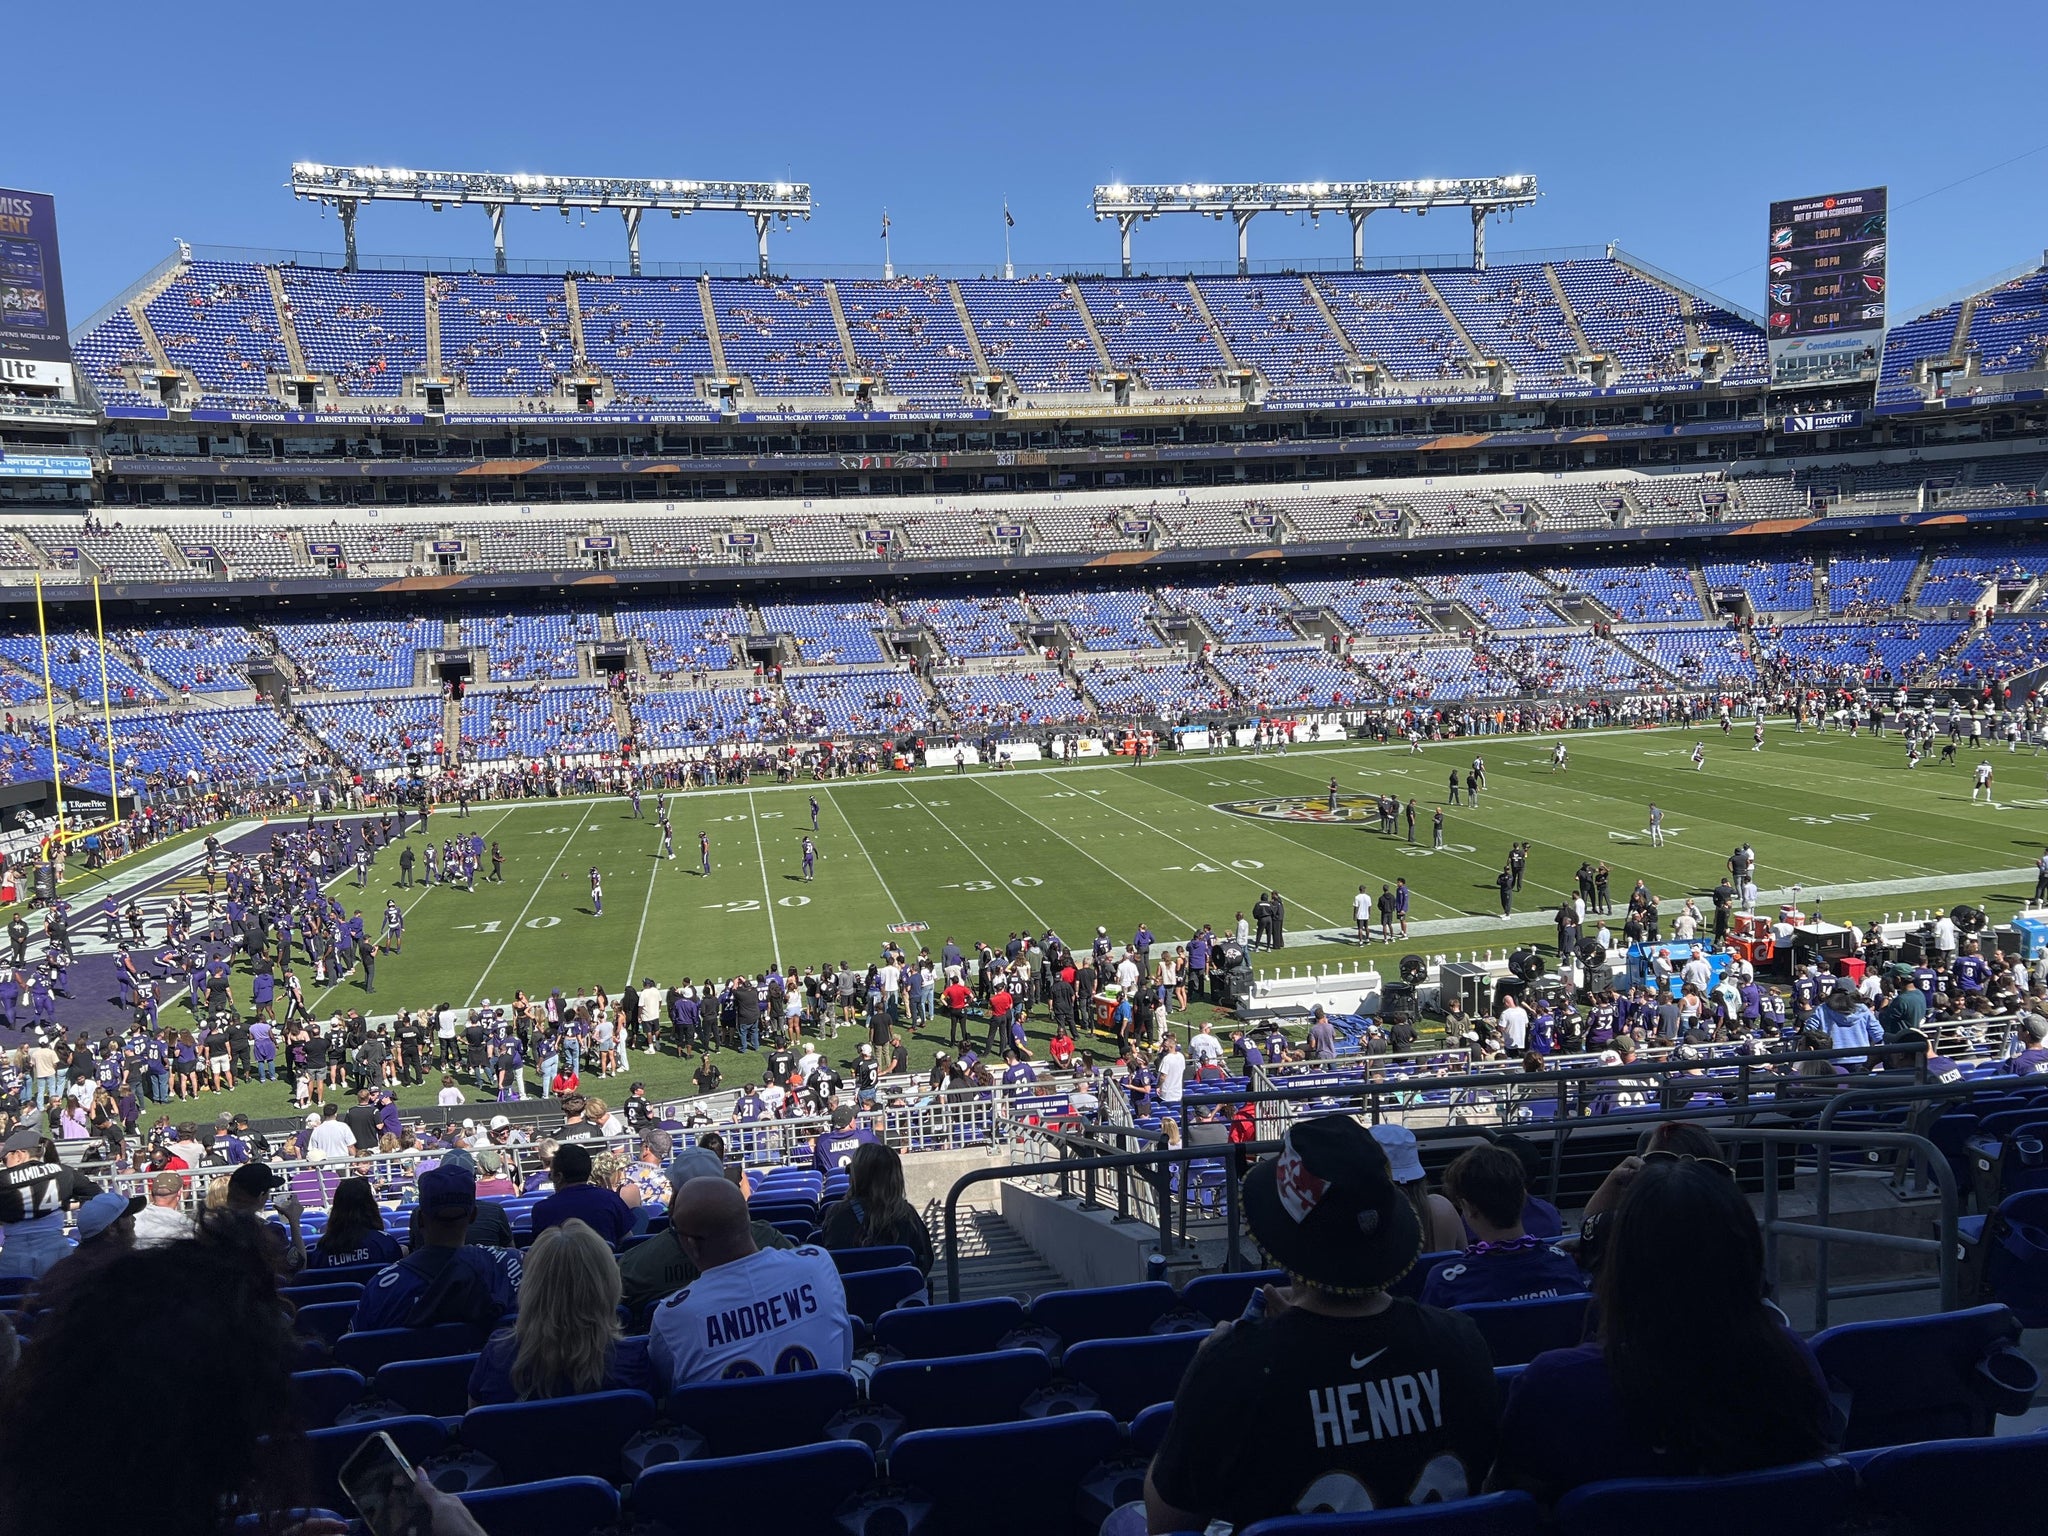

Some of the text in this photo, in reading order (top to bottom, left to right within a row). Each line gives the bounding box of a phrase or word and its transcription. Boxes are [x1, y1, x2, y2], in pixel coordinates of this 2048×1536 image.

[1793, 201, 1824, 212] MARYLAND
[1794, 205, 1863, 222] OUT OF TOWN SCOREBOARD
[1815, 227, 1841, 240] 1:00 PM
[1814, 256, 1840, 268] 1:00 PM
[1813, 283, 1840, 296] 4:05 PM
[1812, 312, 1840, 324] 4:05 PM
[20, 333, 45, 341] MOBILE
[1723, 378, 1769, 388] RING HONOR
[1520, 390, 1592, 401] BRIAN BILLICK 1999-2007
[1616, 384, 1694, 395] HALOTI NGATA 2006-2014
[1350, 401, 1368, 409] JAMAL
[1388, 398, 1417, 406] 2000-2006
[1430, 395, 1493, 405] TODD HEAP 2001-2010
[1127, 407, 1144, 415] LEWIS
[1267, 403, 1282, 411] MATT
[1283, 402, 1305, 410] STOVER
[231, 413, 286, 422] RING HONOR
[315, 415, 410, 424] EARNEST BYNER 1996-2003
[650, 415, 677, 423] ARTHUR
[685, 415, 711, 423] MODELL
[784, 414, 812, 422] McCRARY
[814, 413, 847, 421] 1997-2002
[1016, 410, 1048, 419] JONATHAN
[1071, 408, 1102, 416] 1996-2007
[1815, 413, 1853, 425] merritt
[450, 416, 472, 425] JOHNNY
[473, 416, 492, 424] UNITAS
[497, 416, 508, 424] THE
[51, 460, 90, 468] FACTORY
[996, 453, 1047, 466] 35:37 PREGAME
[961, 876, 1044, 892] 30
[726, 895, 812, 913] 20
[475, 916, 562, 934] 10
[195, 957, 206, 969] 91
[1008, 983, 1022, 995] 20
[1922, 979, 1930, 991] 8
[138, 987, 153, 999] 95
[1596, 1016, 1613, 1030] 52
[149, 1049, 159, 1060] 88
[778, 1061, 785, 1075] 8
[100, 1069, 112, 1081] 88
[819, 1081, 830, 1098] 8
[743, 1103, 754, 1117] 21
[1023, 1102, 1044, 1110] STANDING
[1051, 1099, 1068, 1107] LANDING
[829, 1138, 859, 1153] JACKSON
[9, 1163, 63, 1185] HAMILTON
[18, 1178, 62, 1220] 14
[328, 1246, 370, 1268] FLOWERS
[706, 1283, 818, 1348] ANDREWS
[1309, 1368, 1443, 1449] HENRY
